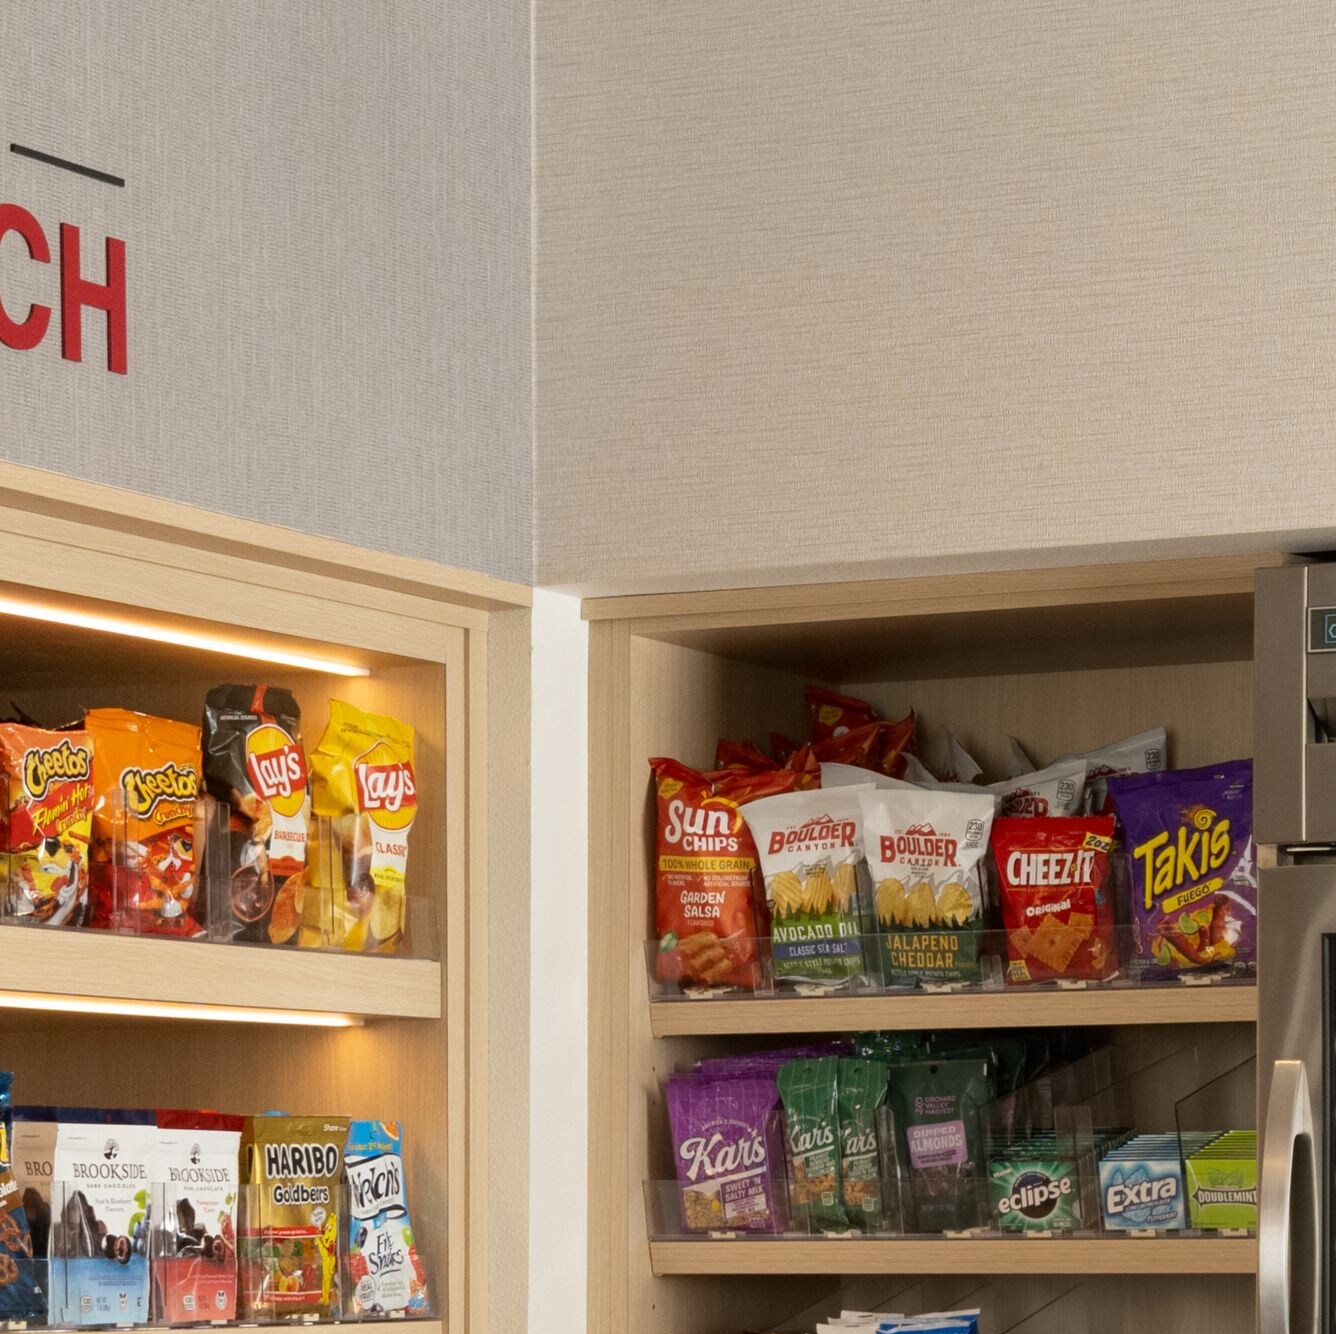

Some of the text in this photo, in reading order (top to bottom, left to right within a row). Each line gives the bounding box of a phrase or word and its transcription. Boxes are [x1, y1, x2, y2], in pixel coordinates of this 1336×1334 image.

[24, 740, 89, 799] Cheetos
[249, 745, 302, 797] Lay's
[122, 763, 197, 816] Cheetos
[358, 763, 415, 811] Lay's
[1060, 782, 1073, 790] 230
[33, 784, 91, 836] Flamin' Hot
[154, 804, 193, 825] Crunchy
[665, 799, 730, 844] Sun
[274, 831, 306, 842] BARBECUE
[683, 835, 738, 851] CHIPS
[768, 821, 856, 855] BOULDER
[788, 842, 836, 853] CANYON
[880, 835, 958, 867] BOULDER
[663, 858, 750, 870] 100% WHOLE GRAIN
[900, 857, 939, 867] CANYON
[1134, 809, 1230, 910] Takis
[680, 890, 726, 904] GARDEN
[1177, 884, 1210, 906] FUEGO
[684, 905, 720, 917] SALSA
[773, 922, 861, 943] AVOCADO OIL
[789, 946, 816, 957] CLASSIC
[891, 952, 954, 969] CHEDDAR
[913, 1126, 956, 1138] DIPPED
[911, 1134, 962, 1152] ALMONDS
[73, 1163, 147, 1180] BROOKSIDE
[266, 1145, 338, 1178] HARIBO
[169, 1167, 231, 1183] BROOKSIDE
[352, 1161, 400, 1208] Welch's
[273, 1184, 329, 1204] Goldbears
[725, 1187, 764, 1202] SALTY MIX
[726, 1179, 751, 1193] SWEET
[998, 1177, 1071, 1213] eclipse
[1107, 1177, 1176, 1214] Extra
